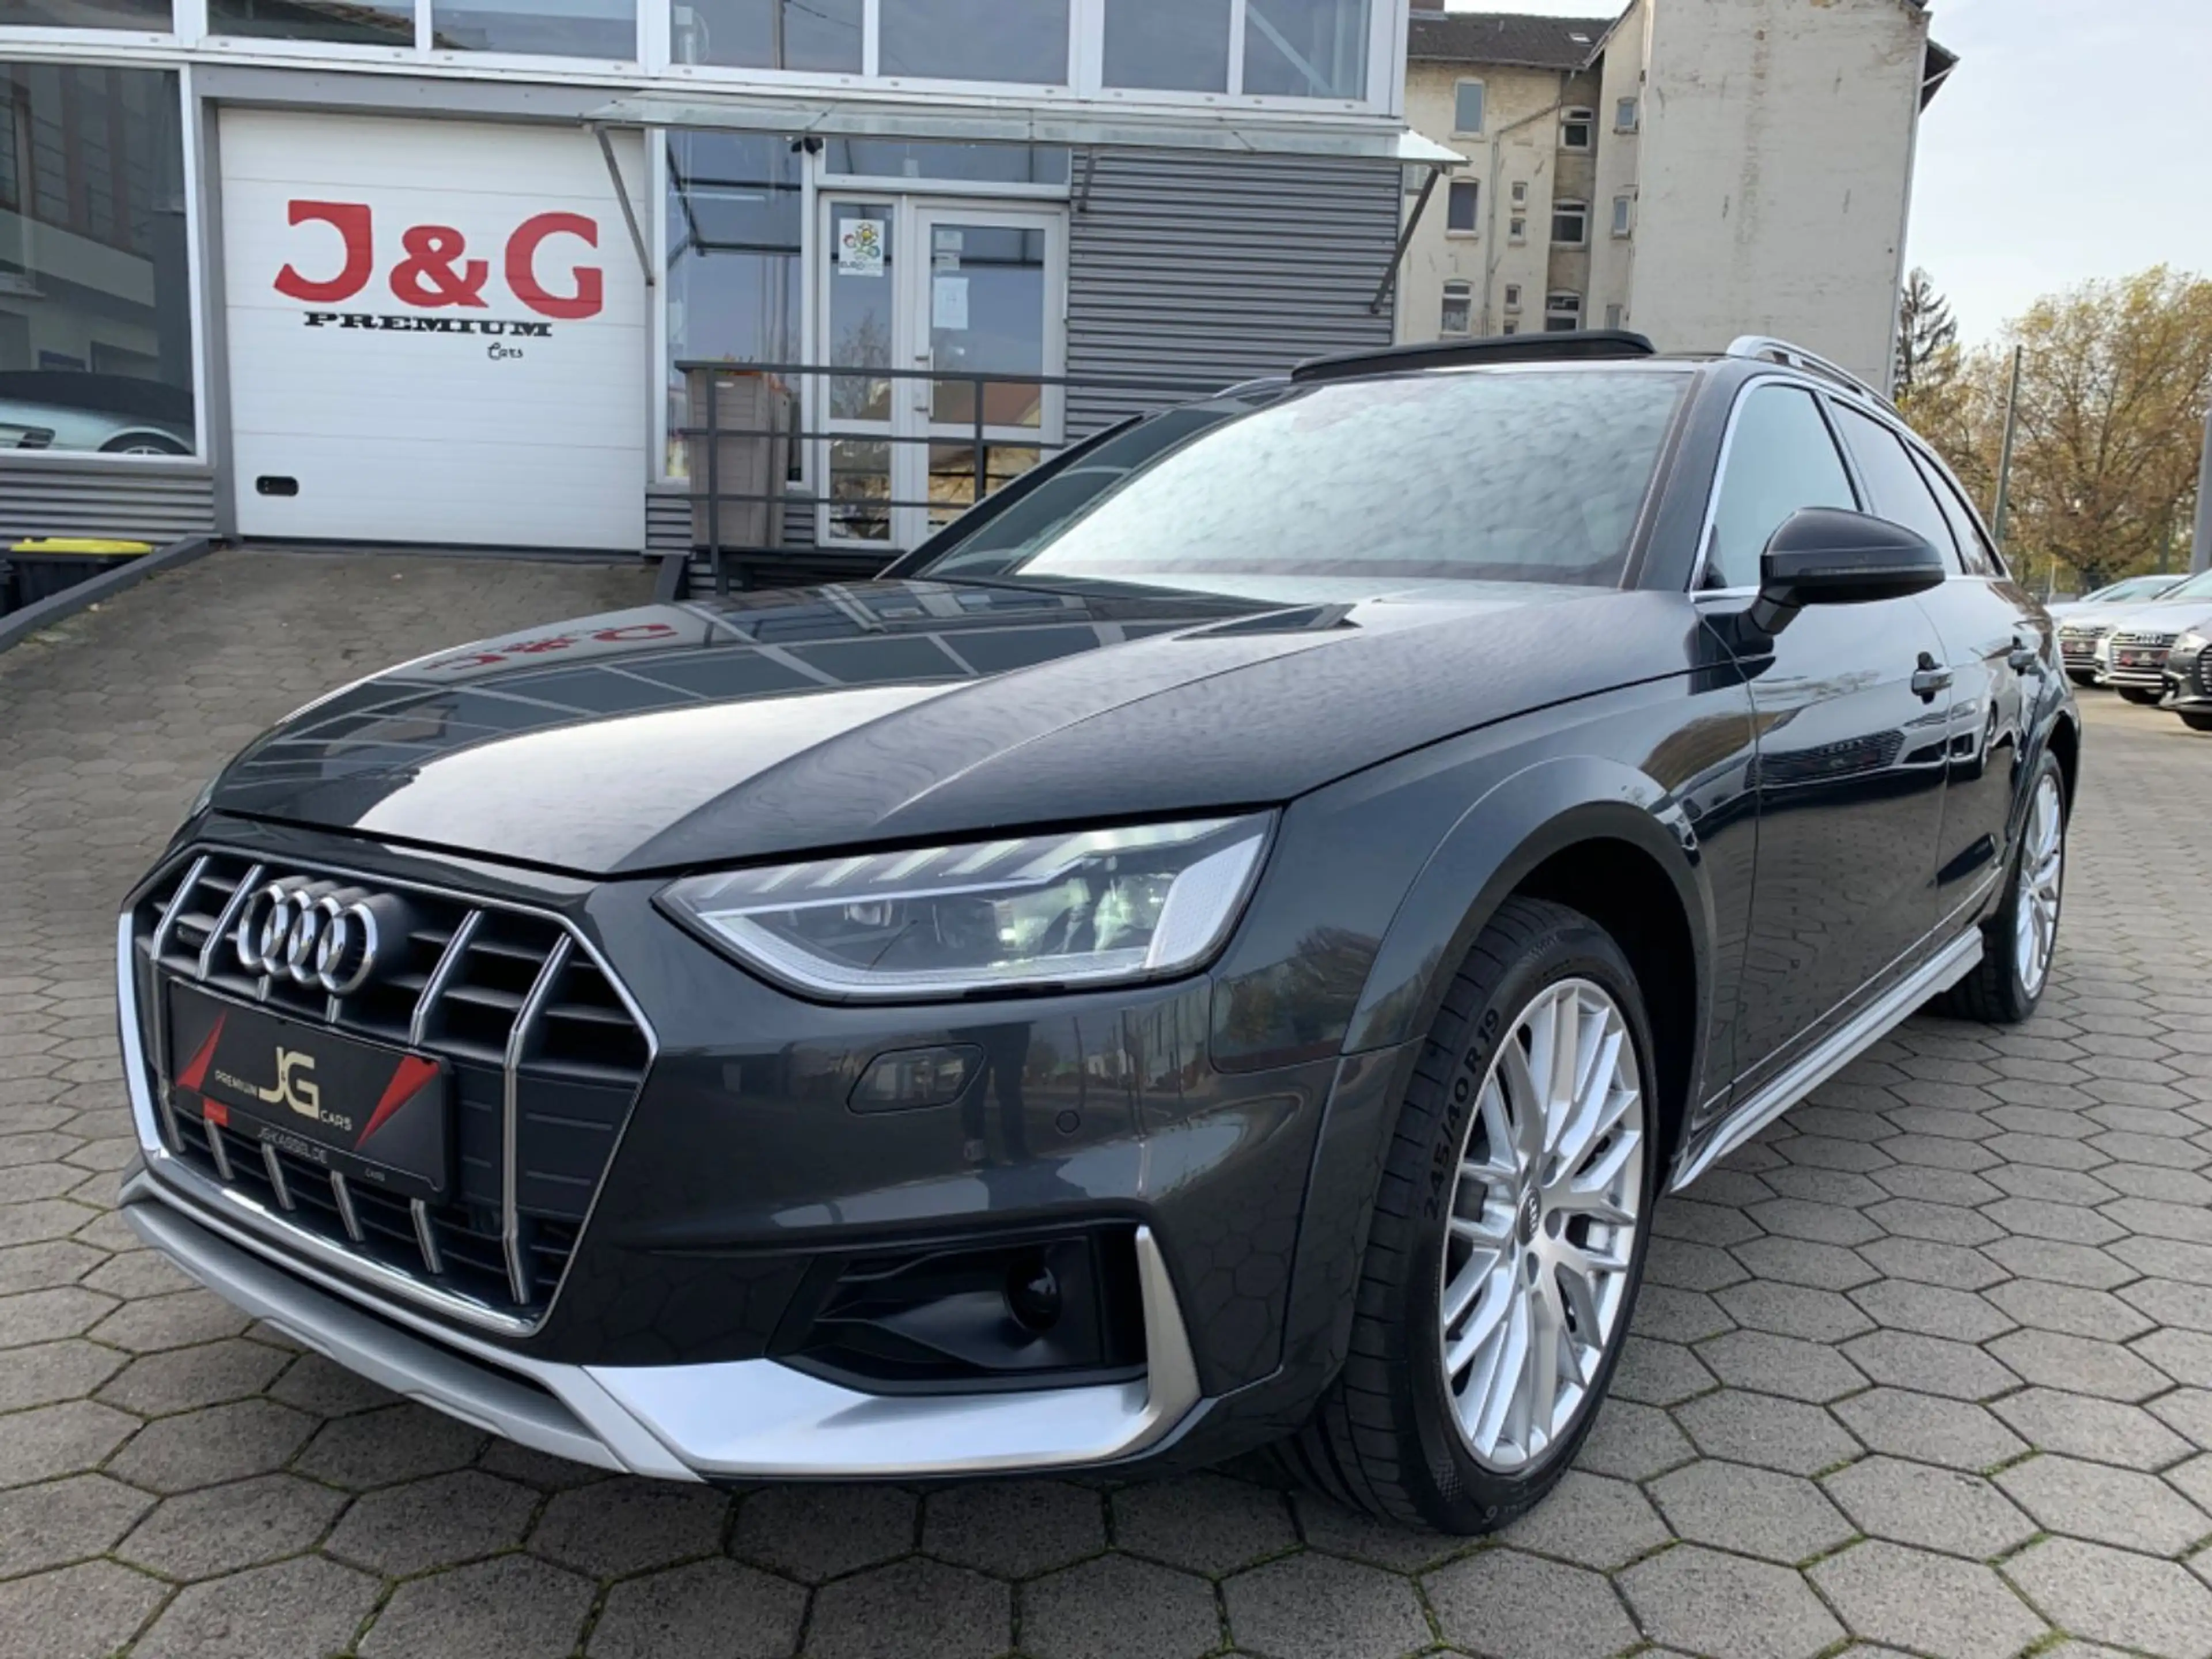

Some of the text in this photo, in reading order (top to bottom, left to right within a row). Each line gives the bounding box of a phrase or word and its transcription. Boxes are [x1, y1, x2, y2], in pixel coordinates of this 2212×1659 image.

[272, 199, 603, 319] J&G
[303, 311, 552, 337] PREMIUM
[487, 342, 524, 361] Cars
[259, 1046, 320, 1119] JG
[320, 1109, 353, 1131] CARS
[1424, 1076, 1469, 1221] 245/40
